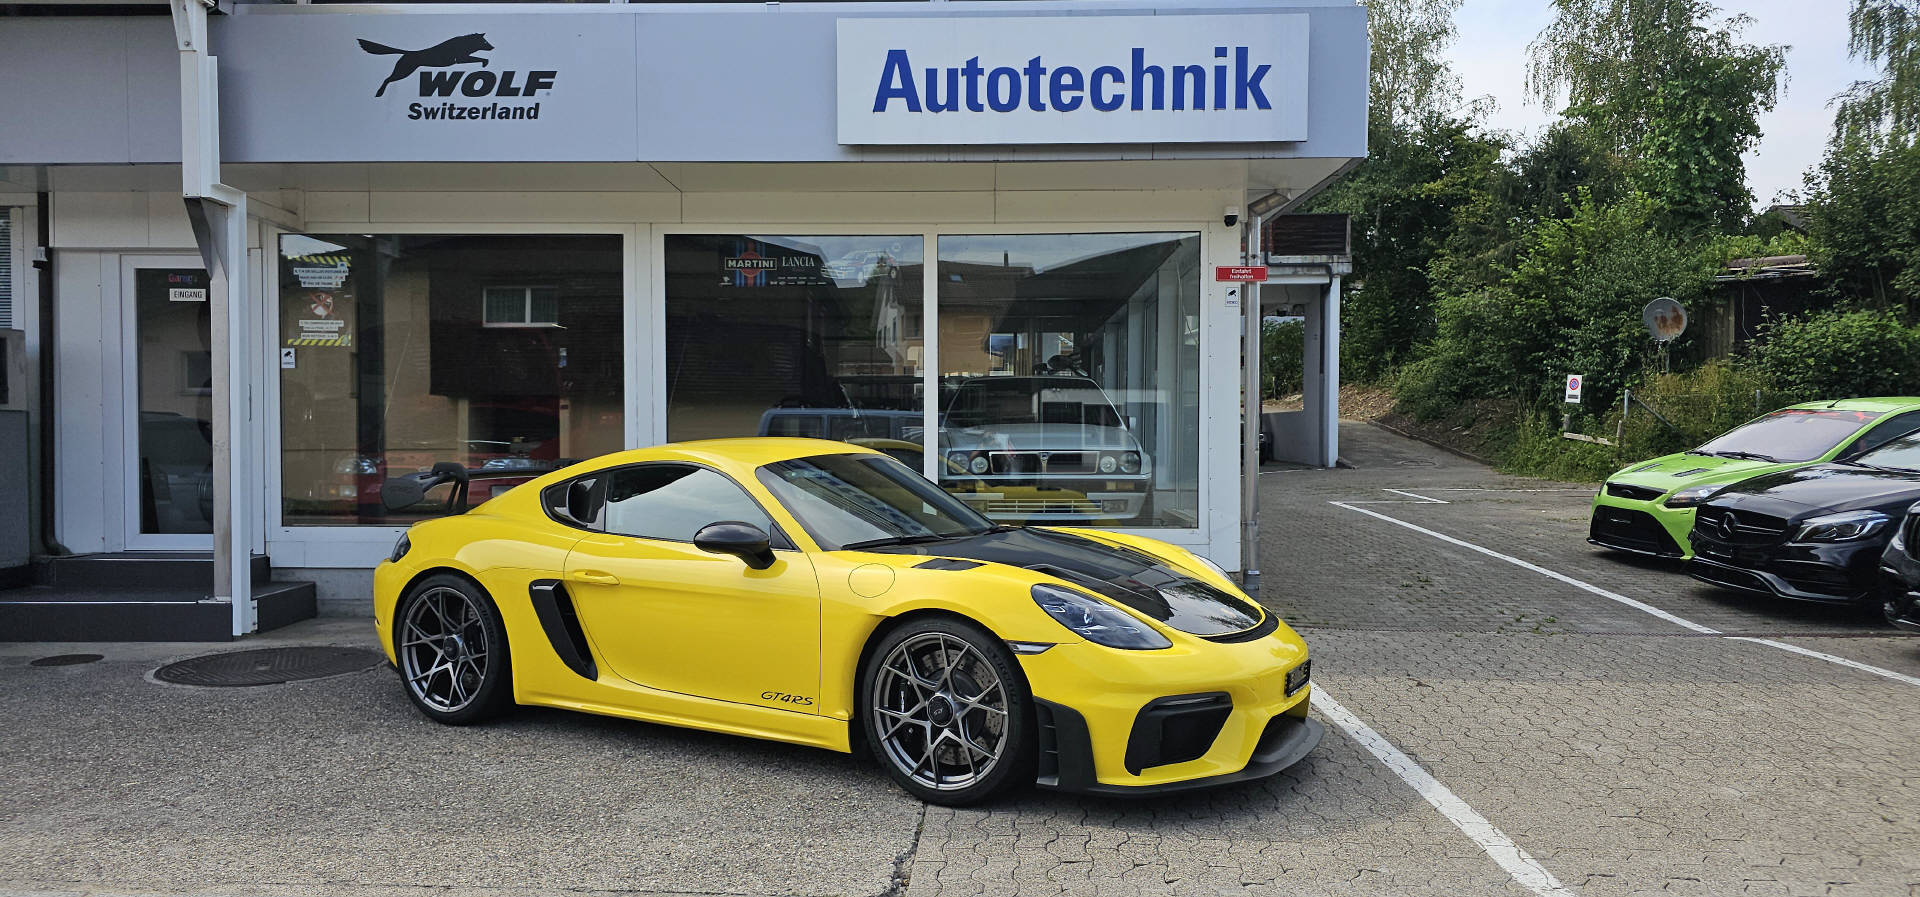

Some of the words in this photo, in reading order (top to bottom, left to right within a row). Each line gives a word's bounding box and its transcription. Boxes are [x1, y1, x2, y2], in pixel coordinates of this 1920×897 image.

[419, 70, 558, 98] WOLF
[873, 46, 1272, 113] Autotechnik
[407, 102, 541, 120] Switzerland
[728, 259, 774, 268] MARTINI
[782, 255, 816, 268] LANCIA
[173, 290, 204, 299] EINGANG
[760, 690, 814, 706] GT4RS
